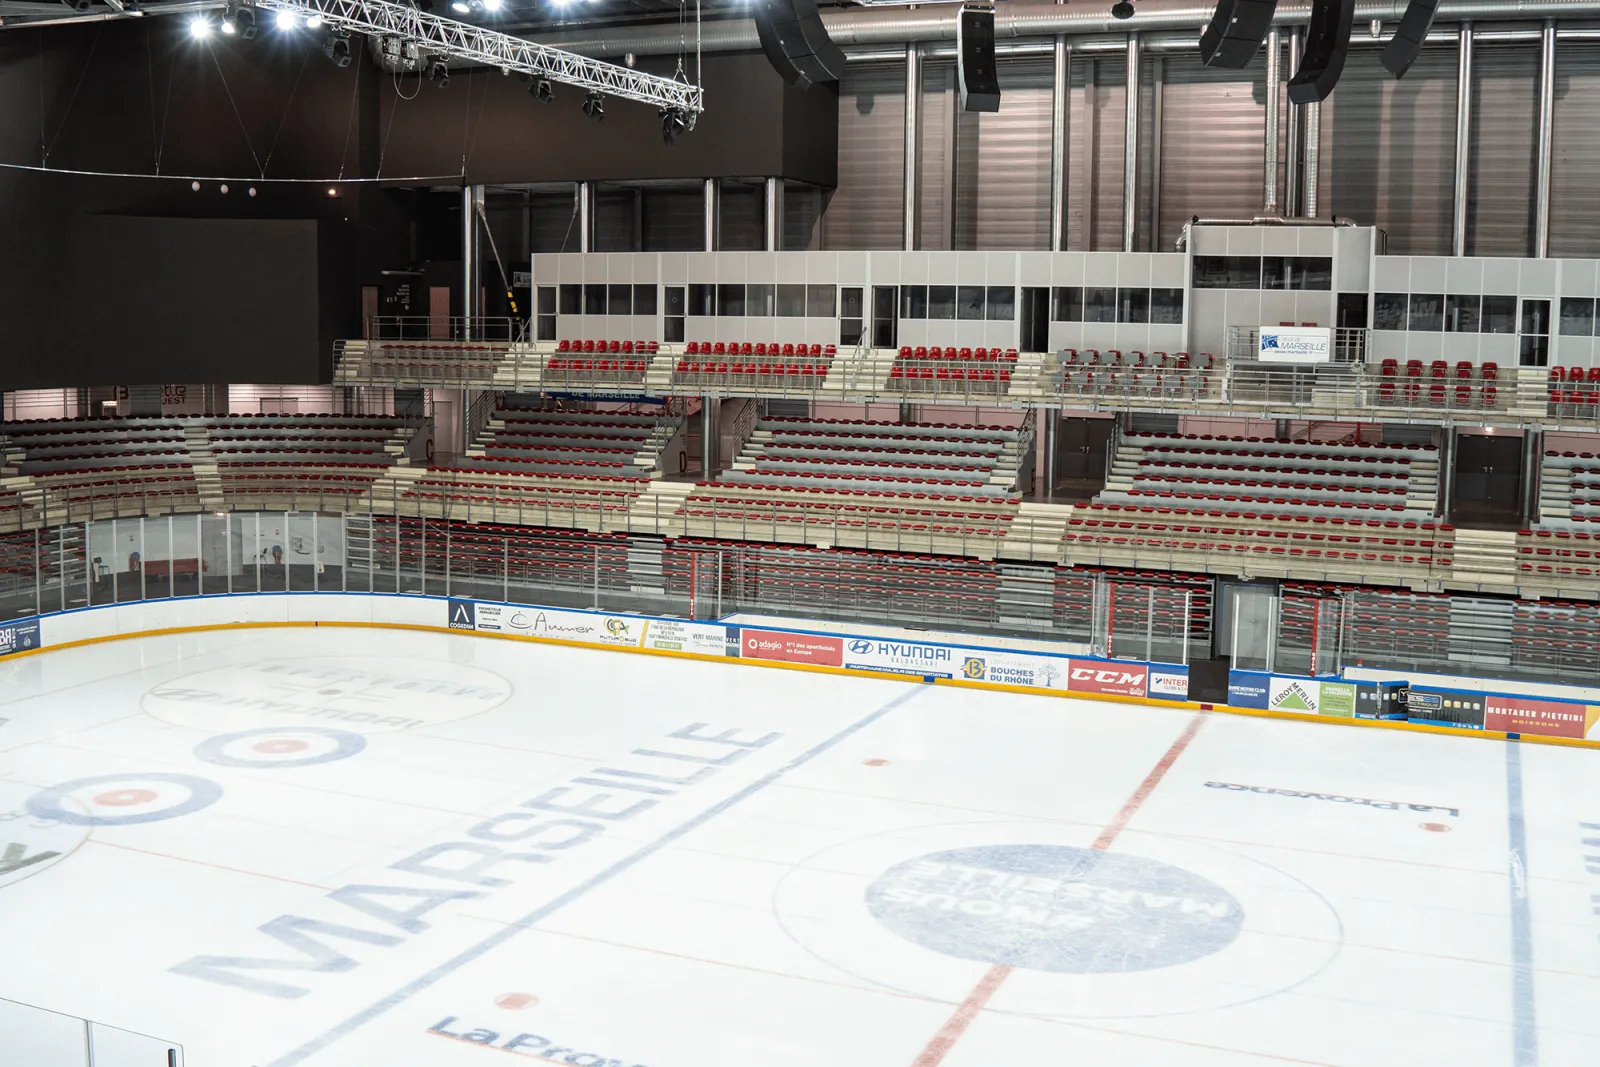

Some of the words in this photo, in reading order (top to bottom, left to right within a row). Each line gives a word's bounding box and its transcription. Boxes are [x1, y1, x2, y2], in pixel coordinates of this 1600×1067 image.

[1280, 342, 1327, 351] MARSEILLE
[449, 622, 474, 630] COGEDIM
[706, 634, 724, 642] MARINE
[759, 640, 782, 650] adagio
[878, 643, 951, 661] HYUNDAI
[891, 658, 938, 667] BALDASSARI
[990, 666, 1035, 677] BOUCHES
[990, 674, 1002, 682] DU
[1004, 675, 1034, 685] RHÔNE
[1070, 667, 1145, 686] CCM
[1163, 678, 1187, 686] INTER
[1271, 685, 1293, 706] LEROY
[1291, 682, 1317, 710] MERLIN
[224, 697, 426, 729] HYUNDAI
[1487, 706, 1537, 718] MONTANER
[1541, 711, 1583, 722] PIETRINI
[1202, 781, 1400, 811] Provence
[1407, 804, 1460, 818] La
[165, 721, 787, 1000] MARSEILLE
[902, 860, 1228, 917] MARSEILLE
[424, 1015, 500, 1045] La
